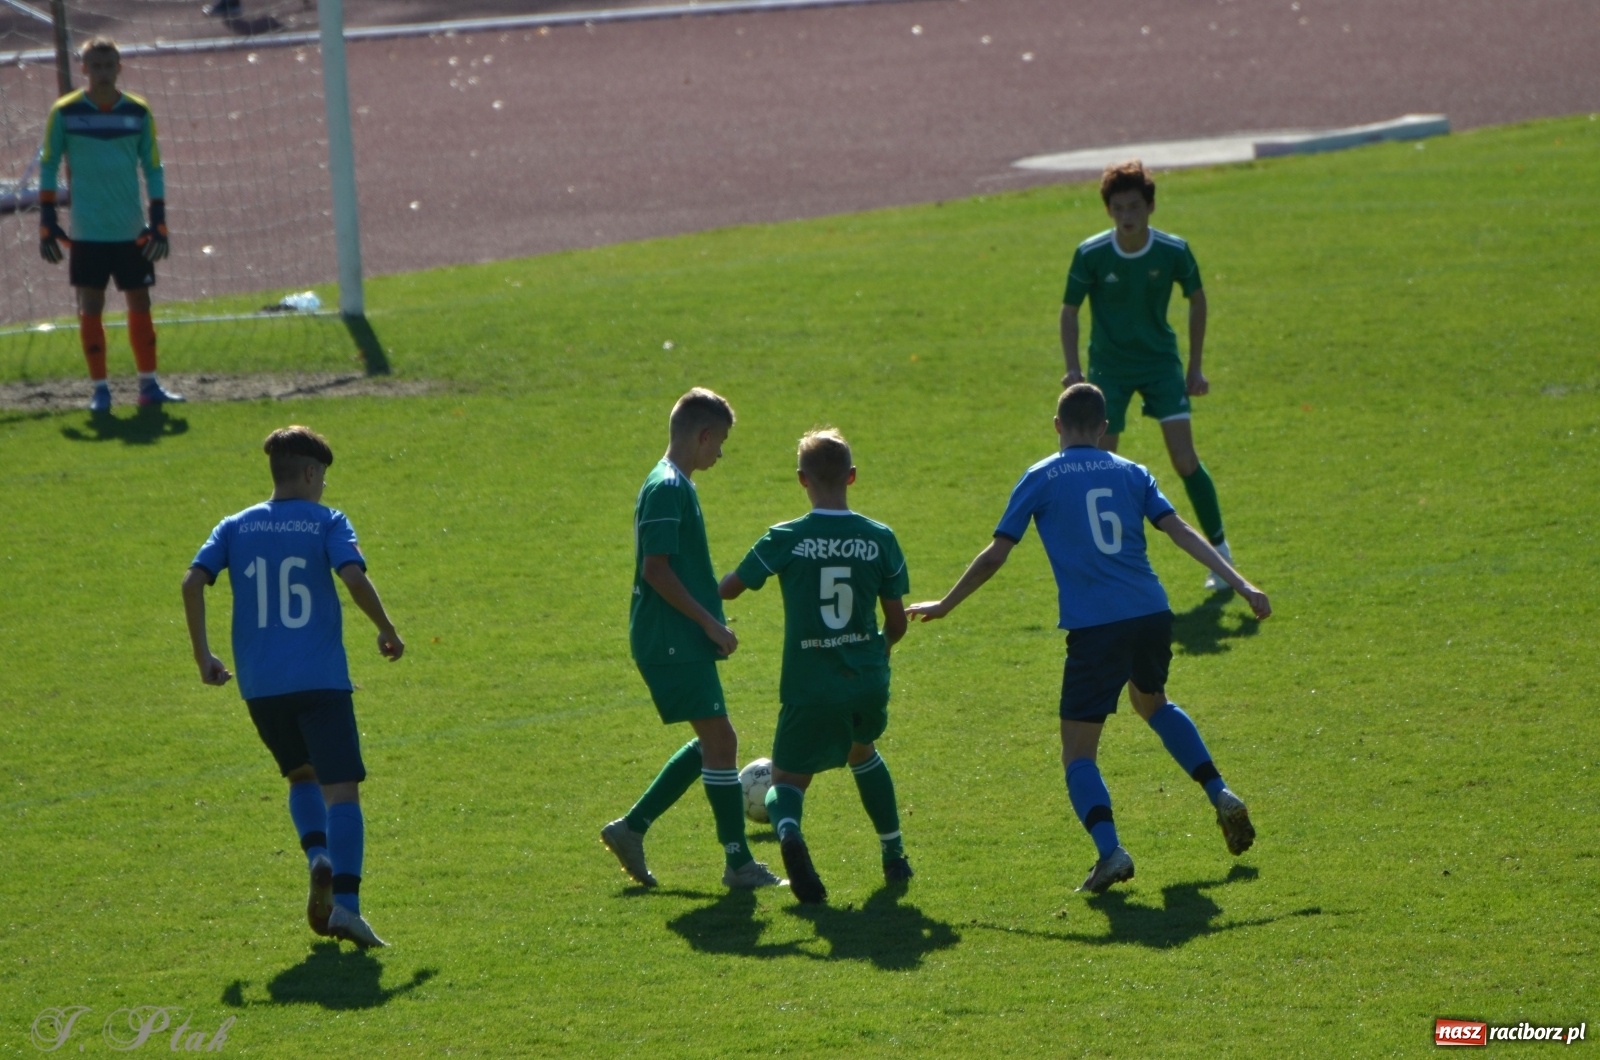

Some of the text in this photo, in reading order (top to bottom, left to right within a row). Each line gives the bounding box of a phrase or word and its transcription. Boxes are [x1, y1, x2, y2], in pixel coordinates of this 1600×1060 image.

[1046, 467, 1058, 480] KS
[1059, 462, 1084, 474] UNIA
[250, 520, 273, 532] UNIA
[1086, 488, 1122, 554] 6
[792, 538, 878, 560] REKORD
[243, 556, 311, 629] 16
[820, 566, 853, 629] 5
